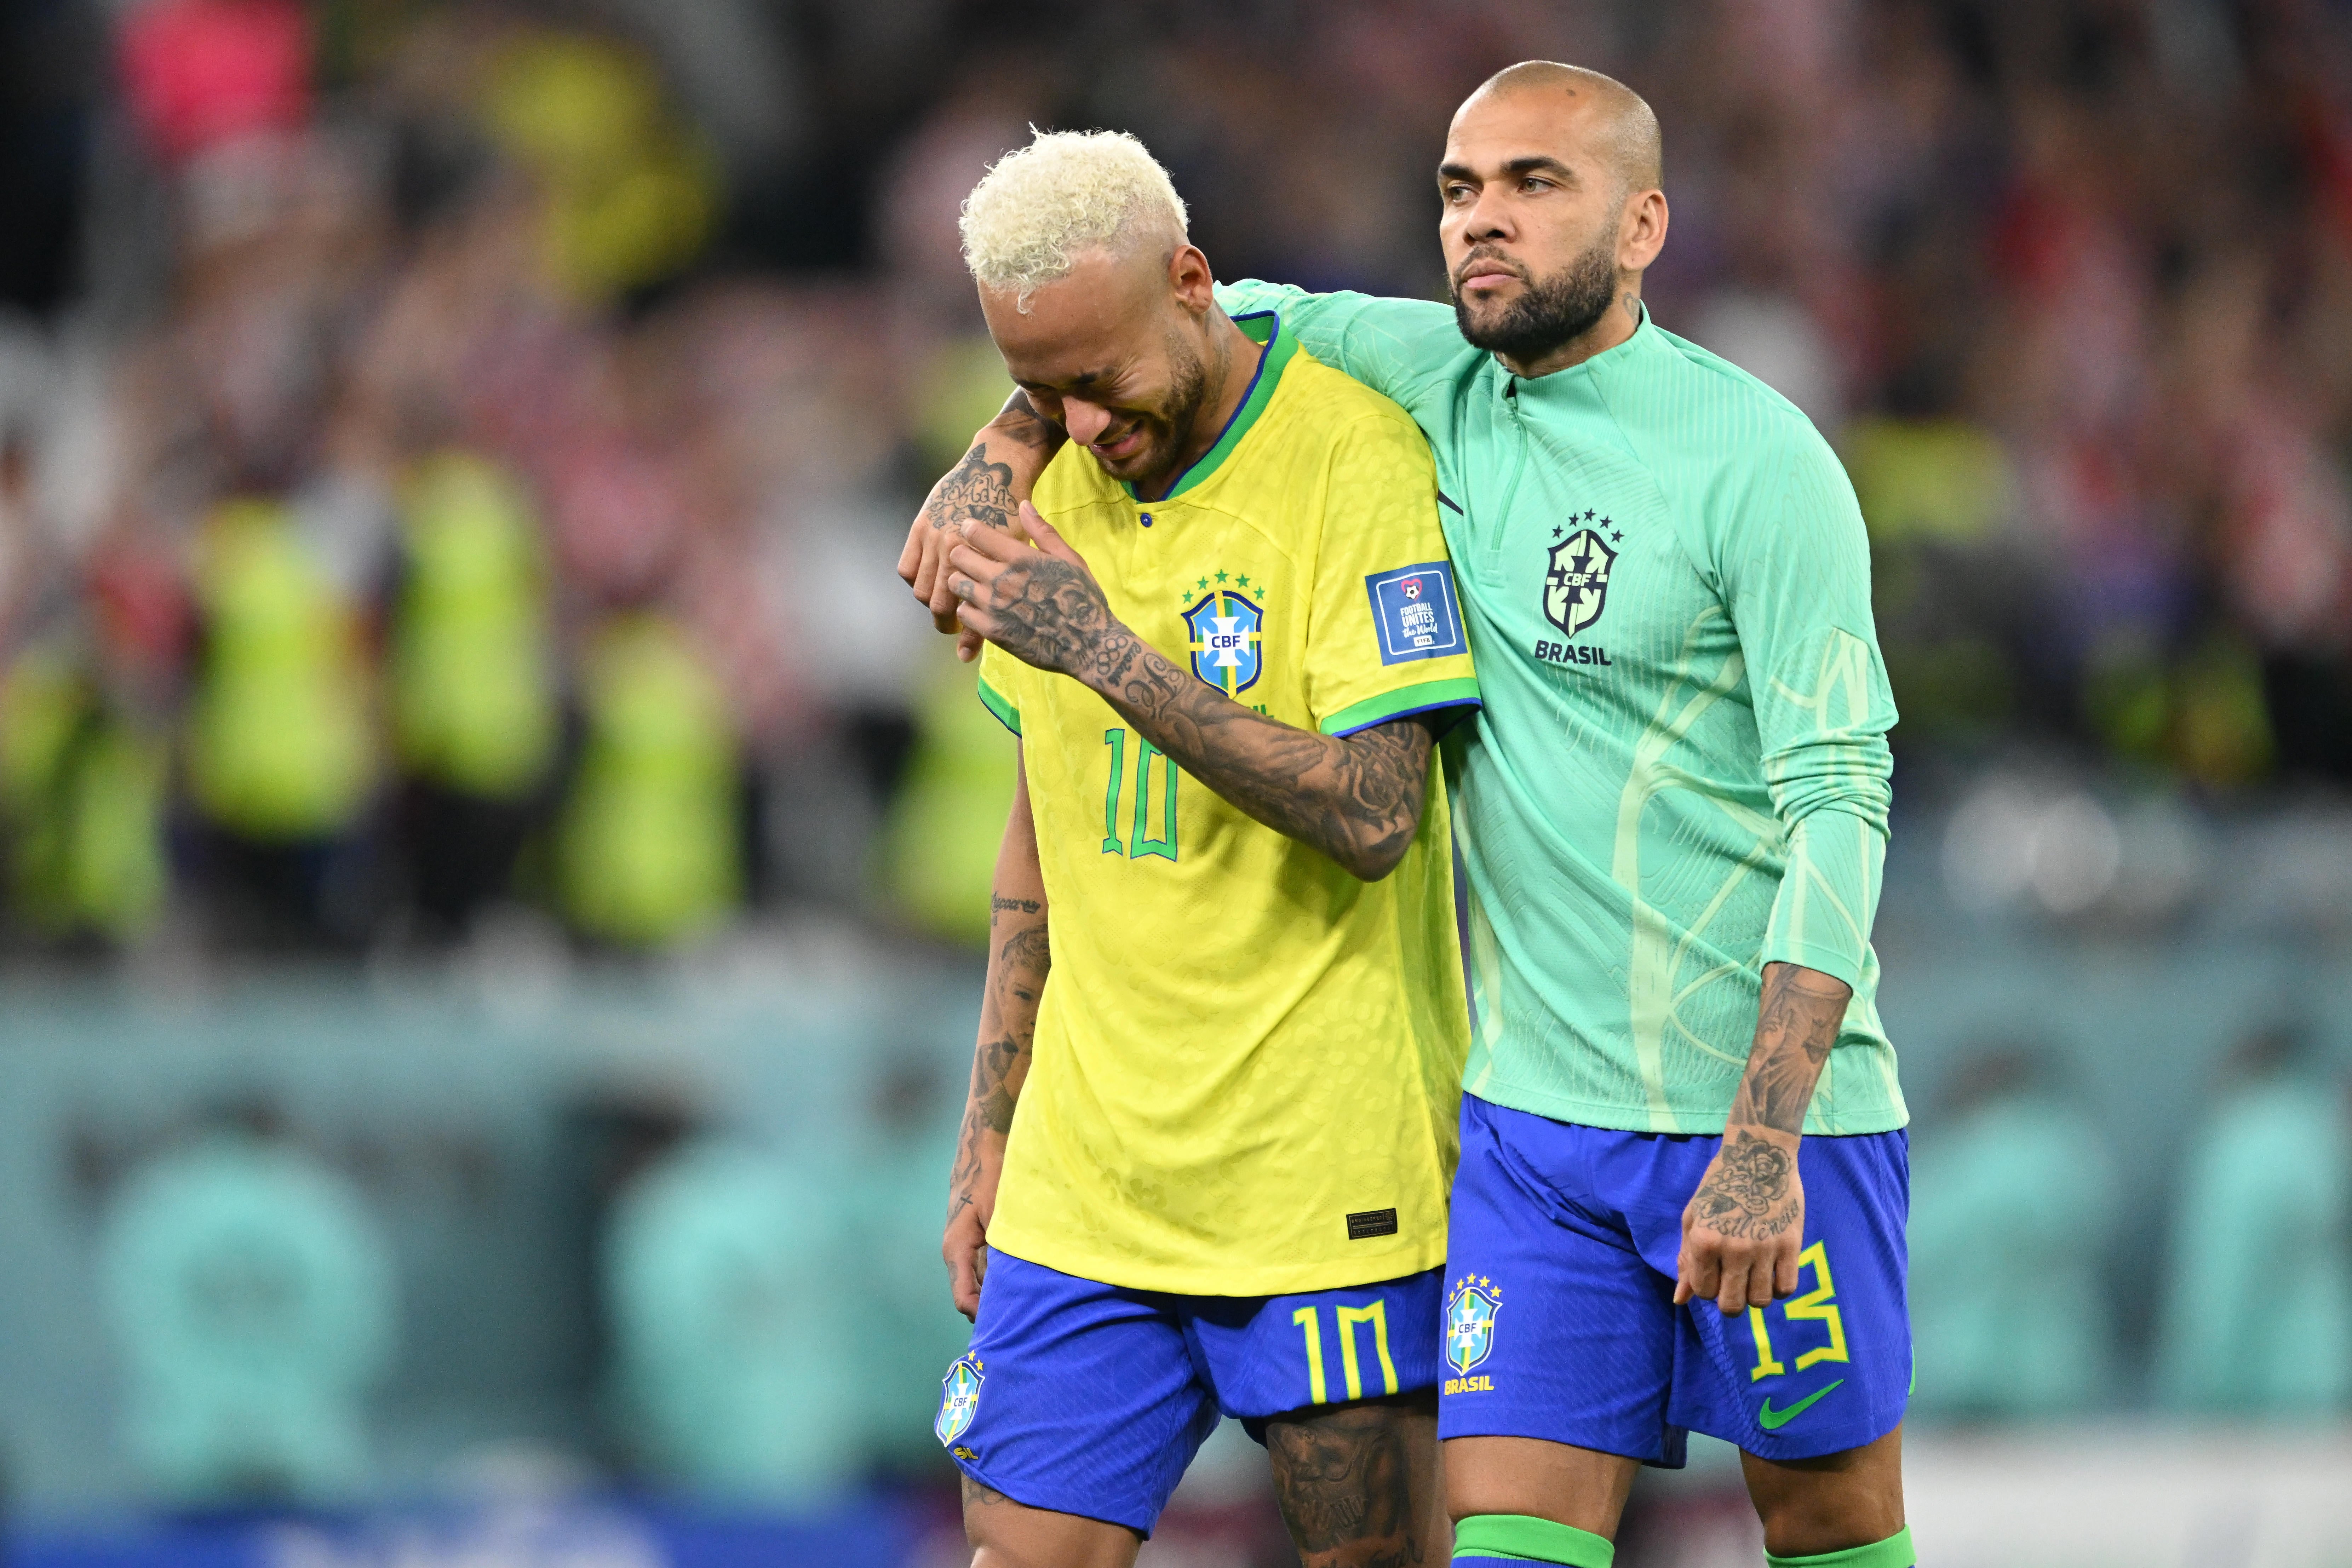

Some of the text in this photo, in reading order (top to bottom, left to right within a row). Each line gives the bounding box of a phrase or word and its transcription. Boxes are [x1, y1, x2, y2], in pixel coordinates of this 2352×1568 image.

[1564, 573, 1592, 587] CBF
[1400, 602, 1433, 616] FOOTBALL
[1402, 611, 1434, 627] UNITES
[1402, 622, 1438, 638] the World
[1211, 636, 1241, 648] CBF
[1534, 640, 1612, 666] BRASIL
[1102, 728, 1178, 863] 10
[1748, 1239, 1850, 1383] 13
[1458, 1322, 1477, 1334] CBF
[1292, 1298, 1399, 1406] 10
[1444, 1375, 1495, 1396] BRASIL
[953, 1397, 968, 1407] CBF
[953, 1447, 979, 1460] SIL
